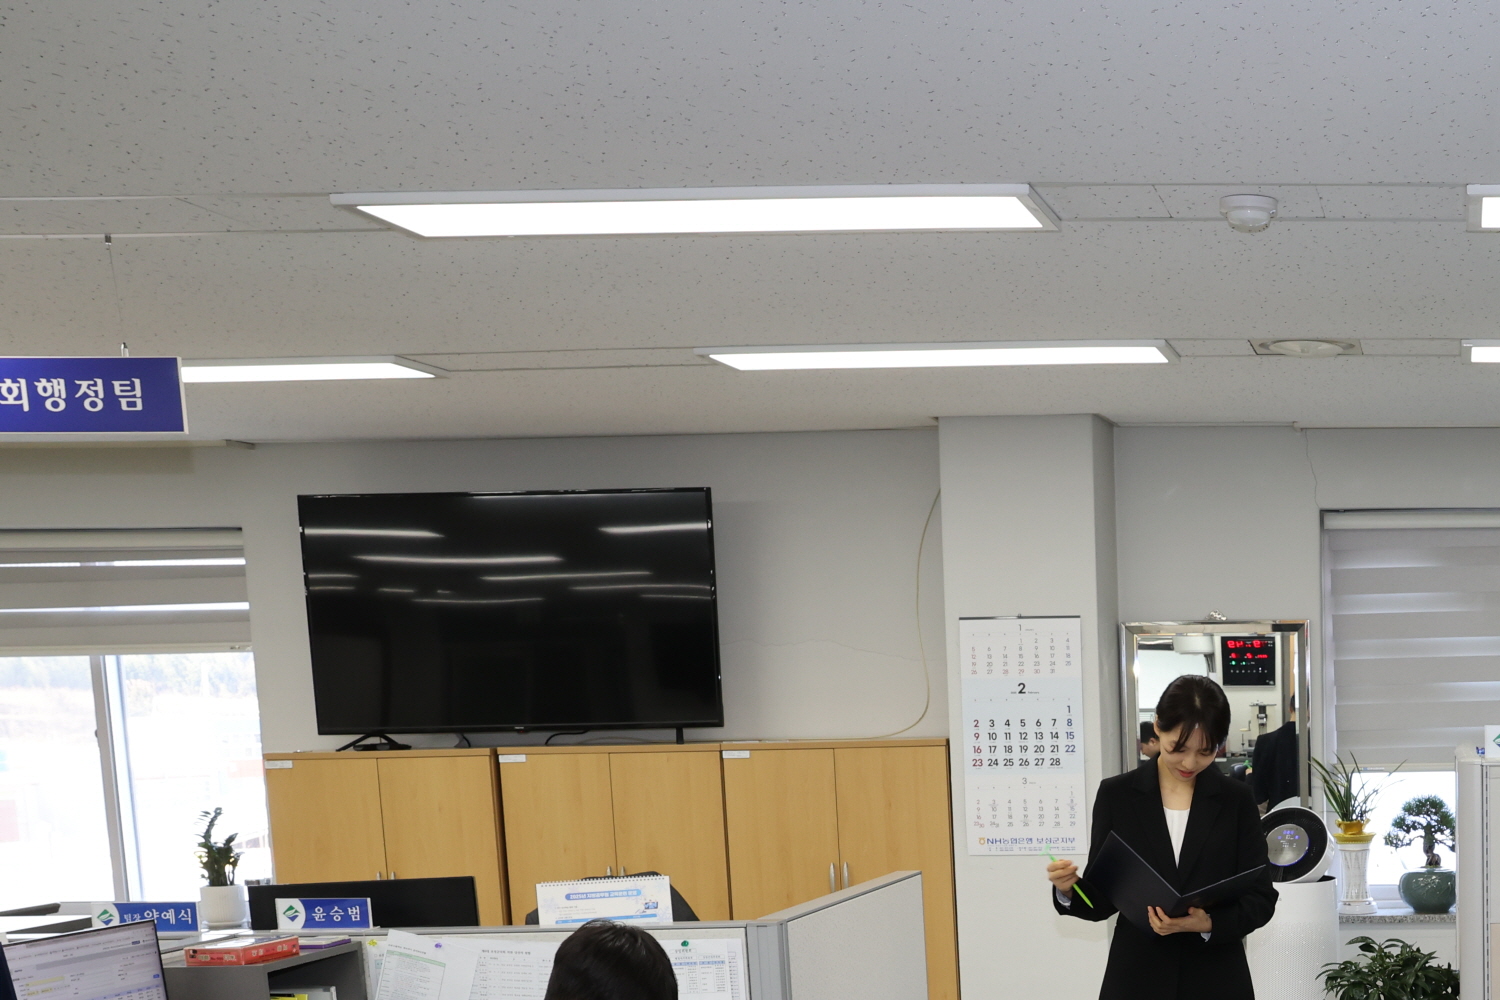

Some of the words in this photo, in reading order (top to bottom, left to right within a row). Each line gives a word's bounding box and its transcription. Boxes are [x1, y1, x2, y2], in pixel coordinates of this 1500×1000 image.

[0, 378, 143, 412] 회행정팀
[1018, 682, 1026, 694] 2
[1067, 705, 1071, 714] 1
[973, 719, 979, 728] 2
[989, 719, 995, 728] 3
[1004, 719, 1011, 727] 4
[1020, 719, 1026, 727] 5
[1035, 719, 1042, 727] 6
[1051, 718, 1057, 727] 7
[1066, 718, 1073, 727] 8
[974, 732, 980, 741] 9
[988, 732, 997, 741] 10
[1004, 732, 1011, 740] 11
[1019, 732, 1028, 740] 12
[1034, 732, 1044, 740] 13
[1050, 731, 1059, 740] 14
[1065, 731, 1075, 740] 15
[973, 745, 982, 754] 16
[988, 745, 997, 754] 17
[1003, 745, 1013, 753] 18
[1019, 745, 1028, 753] 19
[1034, 745, 1045, 753] 20
[1050, 745, 1059, 753] 21
[1065, 744, 1076, 753] 22
[972, 758, 983, 767] 23
[987, 758, 999, 767] 24
[1003, 758, 1014, 767] 25
[1018, 758, 1030, 767] 26
[1034, 758, 1045, 766] 27
[1049, 758, 1061, 766] 28
[1022, 777, 1028, 785] 3
[311, 905, 361, 922] 윤승범
